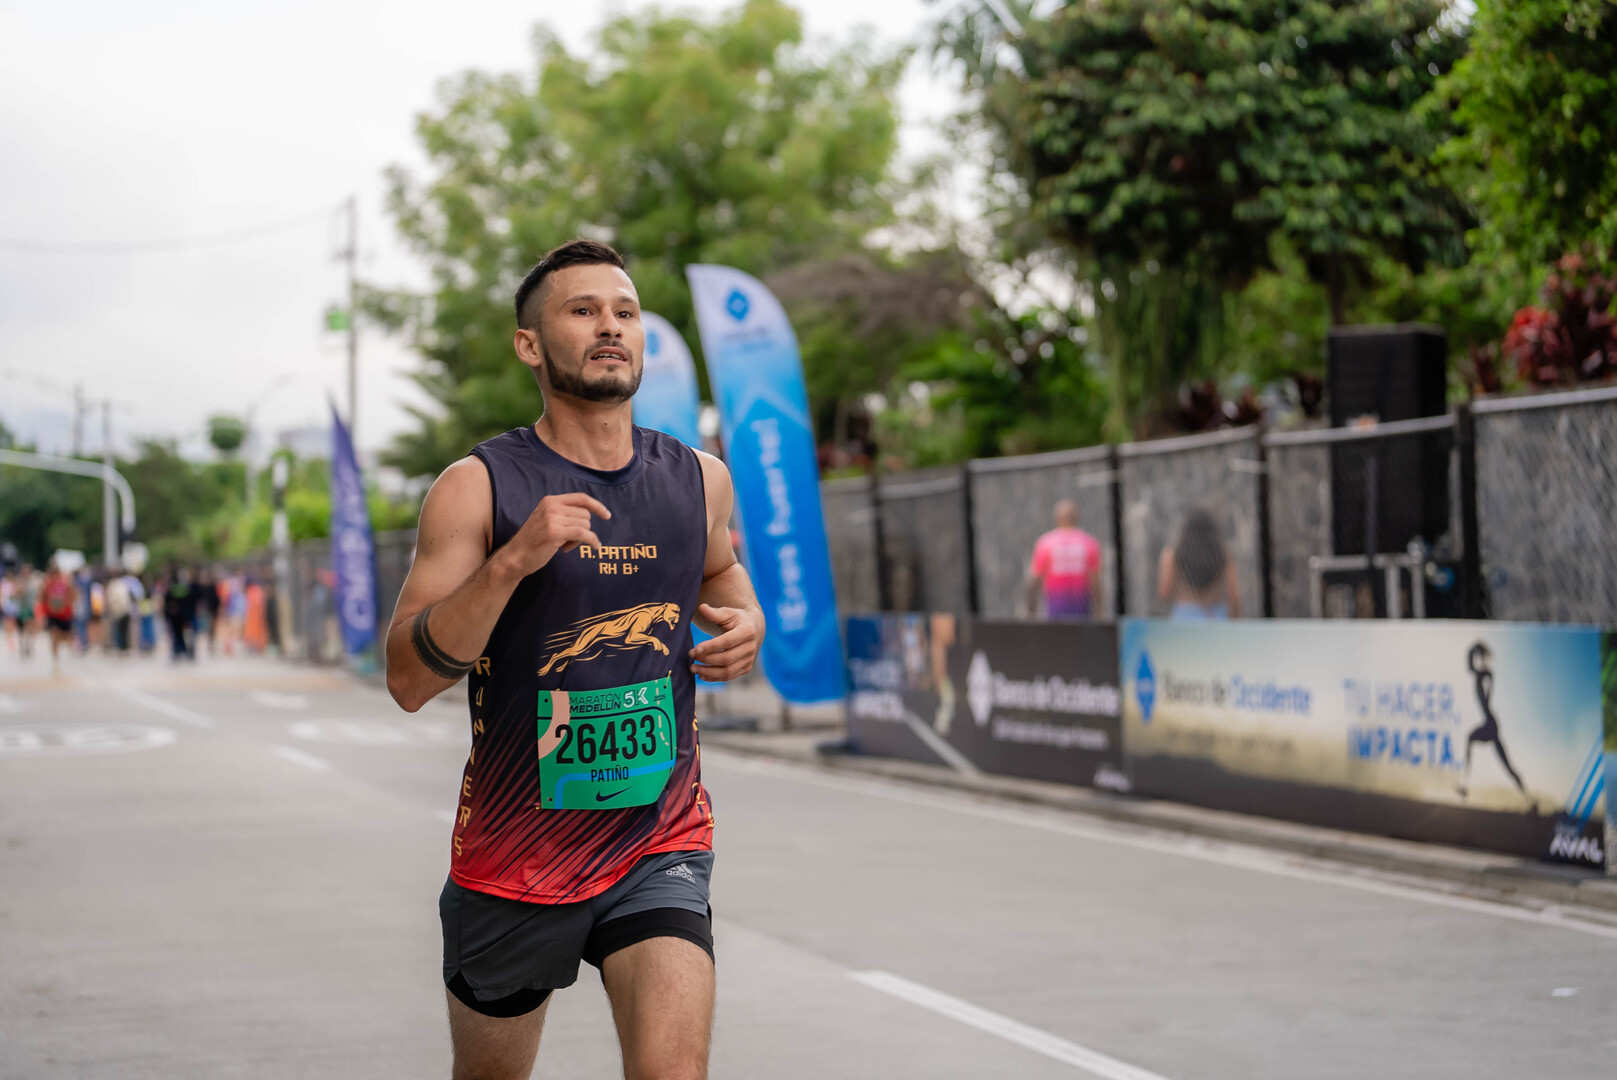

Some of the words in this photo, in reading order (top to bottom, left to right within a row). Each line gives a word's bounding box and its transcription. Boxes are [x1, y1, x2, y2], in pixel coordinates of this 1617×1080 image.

[579, 545, 596, 559] A.
[598, 543, 658, 560] PATIÑO
[599, 562, 618, 575] RH
[622, 562, 640, 575] B+
[569, 692, 621, 705] MARATÓN
[623, 687, 649, 708] 5K
[1230, 674, 1313, 715] Occidente
[1343, 678, 1371, 717] TU
[569, 700, 621, 713] MEDELLÍN
[555, 715, 657, 764] 26433
[1346, 726, 1464, 771] IMPACTA.
[590, 765, 629, 782] PATIÑO
[1549, 833, 1604, 863] AVAL
[665, 869, 696, 883] adidas
